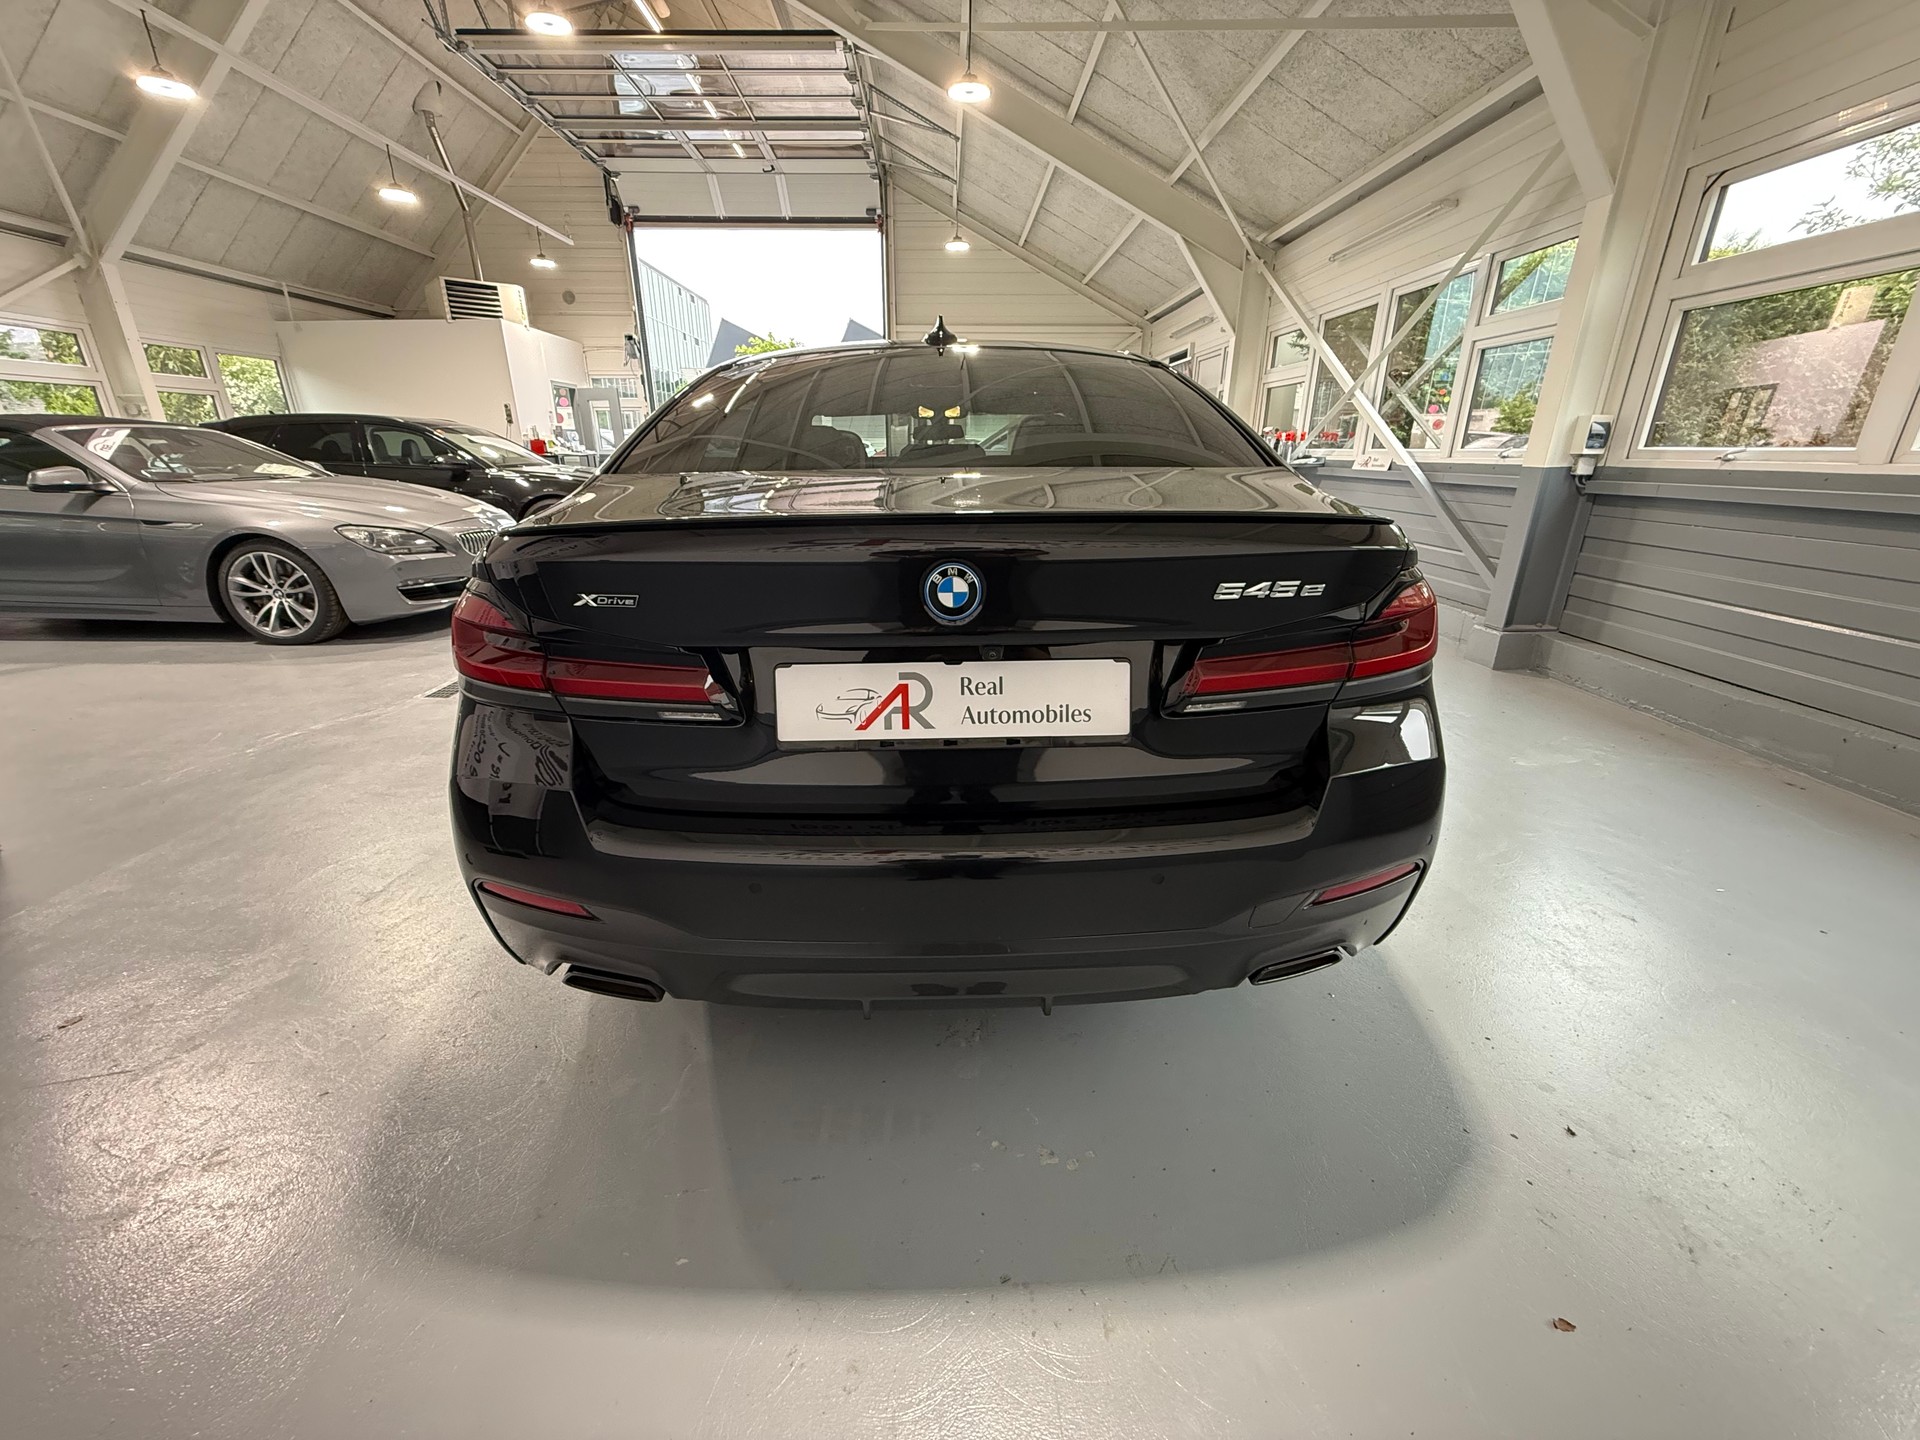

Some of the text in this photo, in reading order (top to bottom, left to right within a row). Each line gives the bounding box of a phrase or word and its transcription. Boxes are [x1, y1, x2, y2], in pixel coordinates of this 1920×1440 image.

[932, 567, 975, 585] BMW
[1213, 580, 1326, 600] 545e
[960, 676, 1004, 696] Real
[961, 704, 1092, 725] Automobiles
